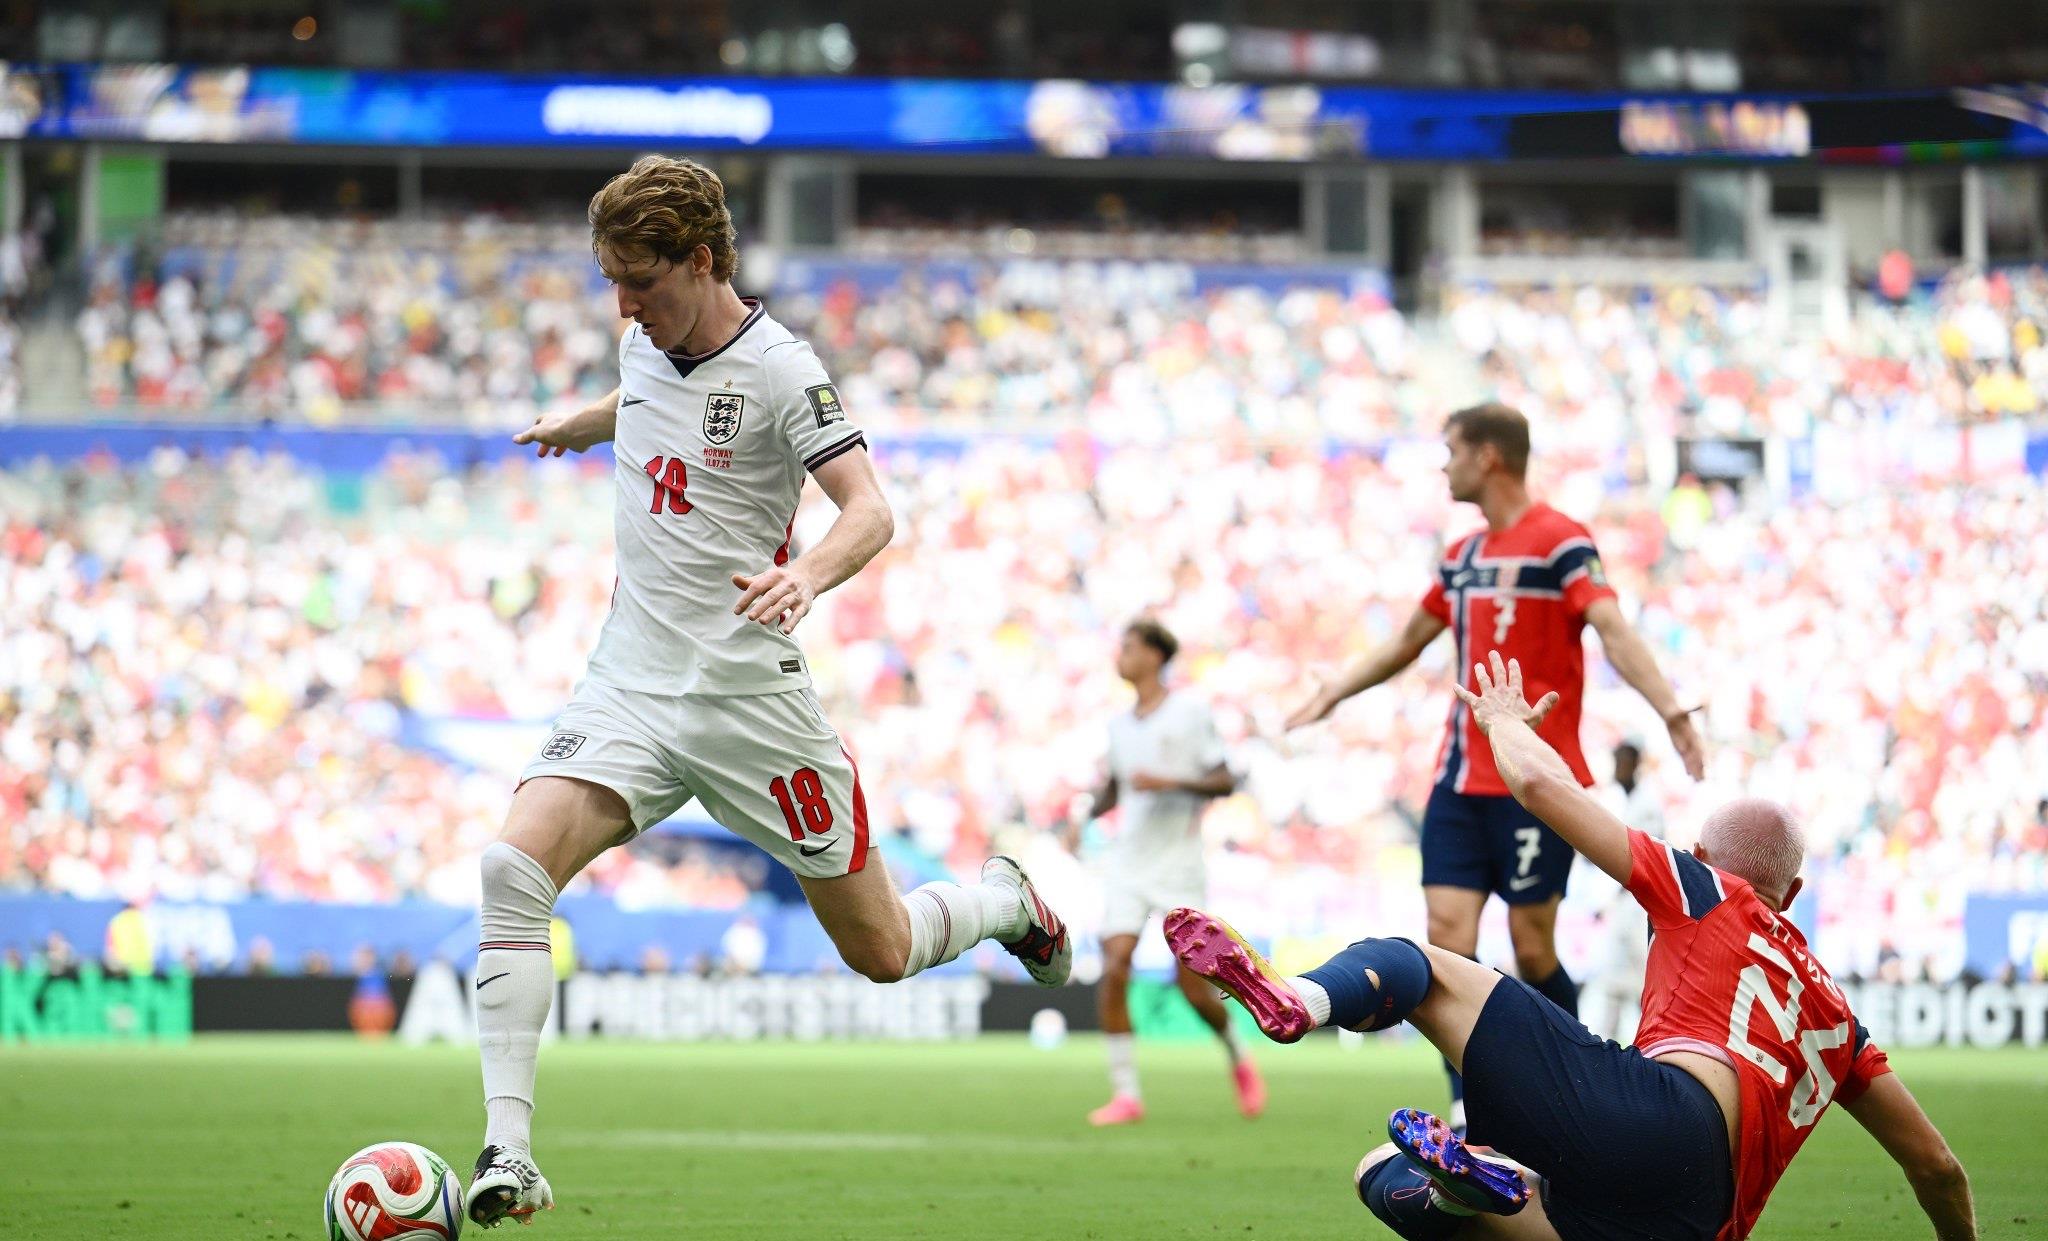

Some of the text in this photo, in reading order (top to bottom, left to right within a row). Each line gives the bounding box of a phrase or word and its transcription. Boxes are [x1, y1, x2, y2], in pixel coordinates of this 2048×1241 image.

[703, 447, 733, 459] NORWAY
[769, 766, 834, 841] 18
[1514, 827, 1541, 876] 7
